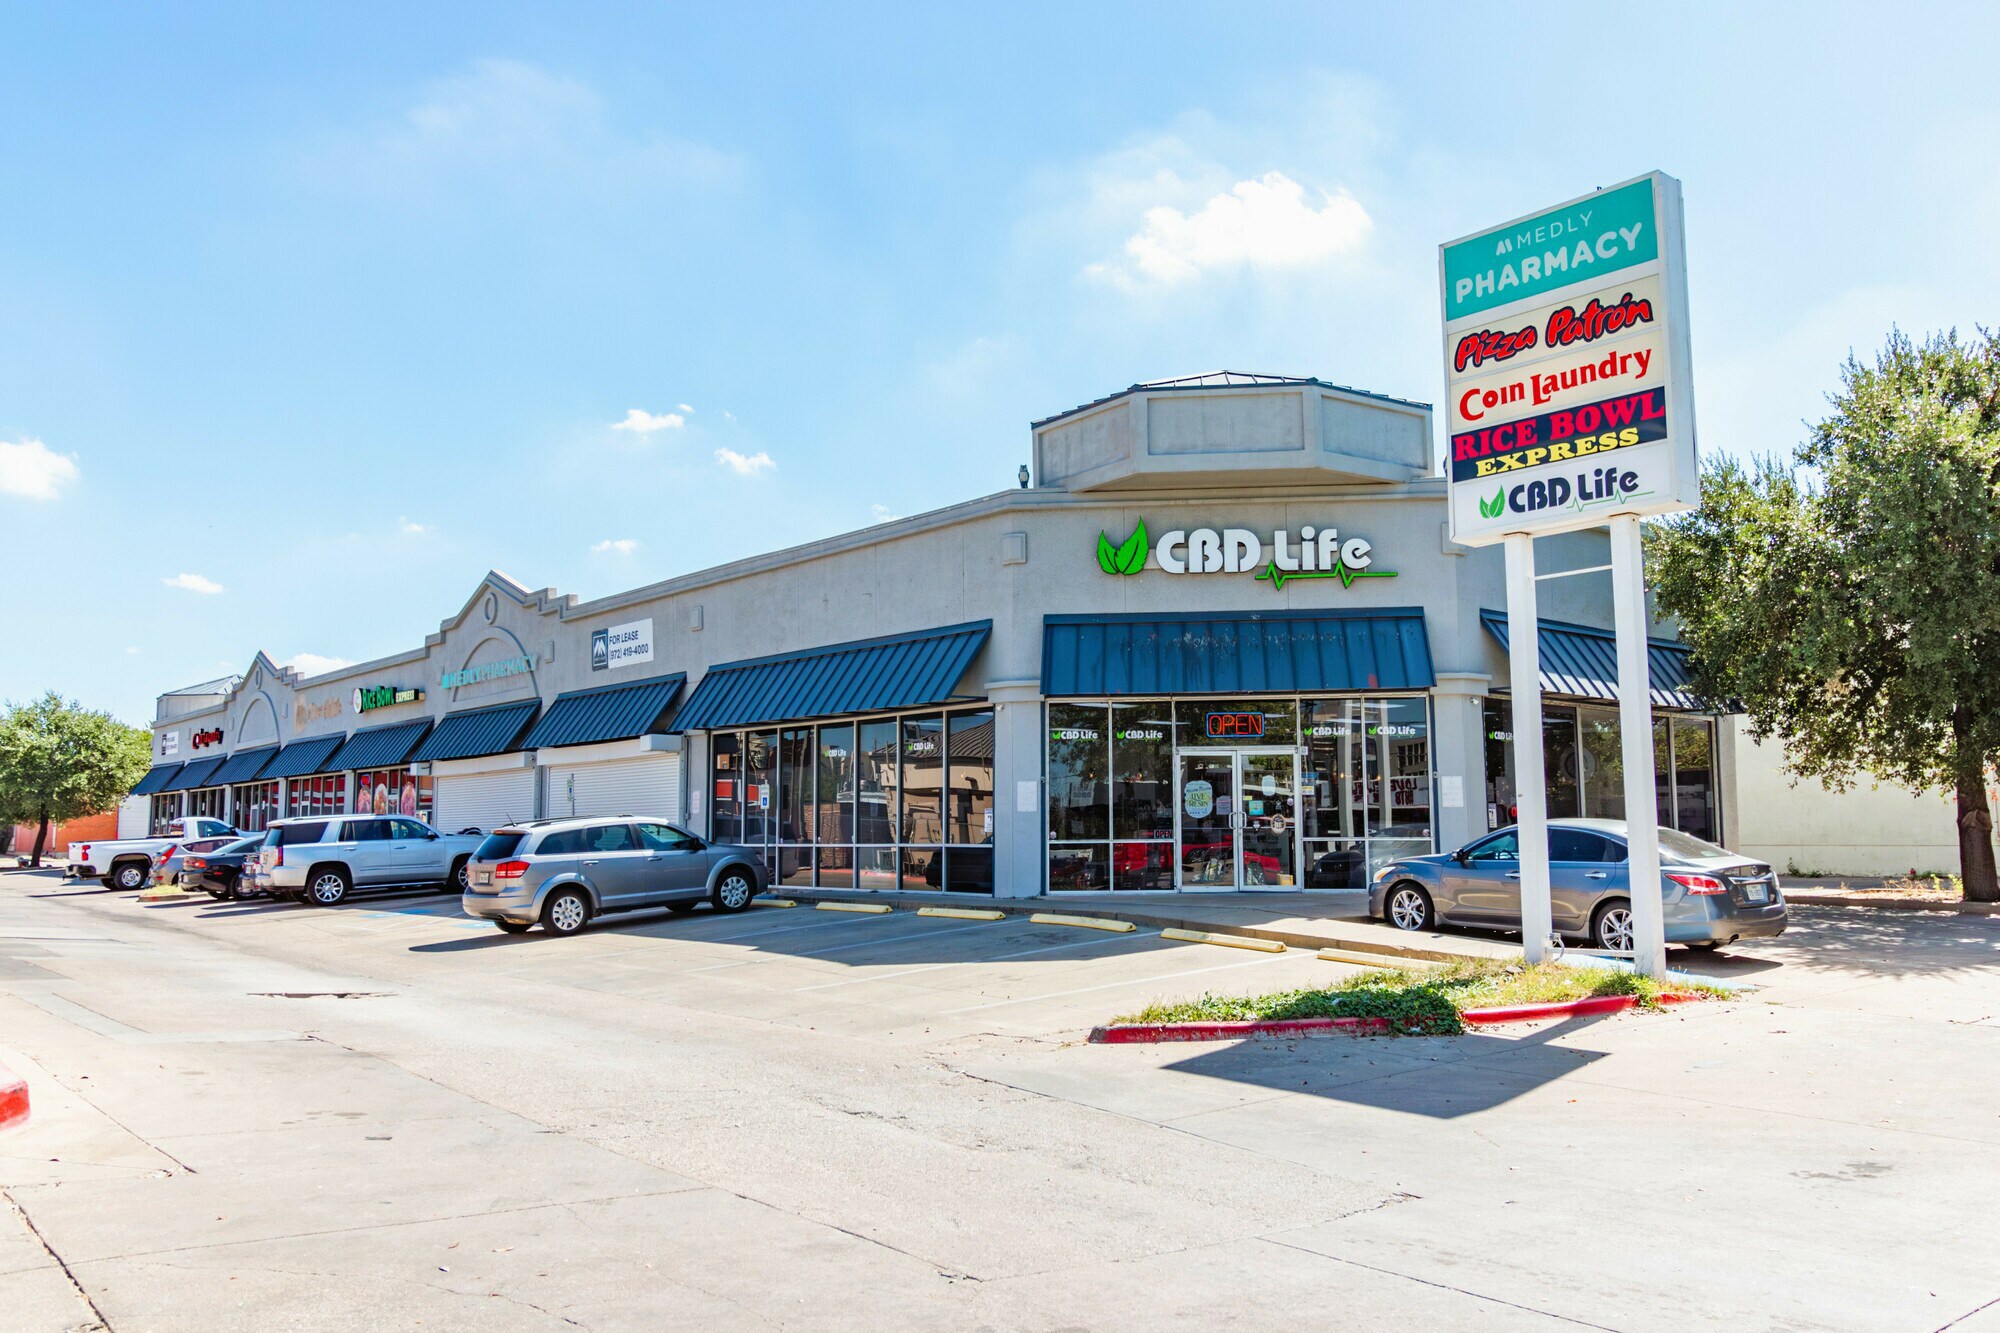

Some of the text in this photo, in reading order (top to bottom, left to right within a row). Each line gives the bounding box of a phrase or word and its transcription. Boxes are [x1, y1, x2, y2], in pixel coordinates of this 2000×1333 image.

[1517, 210, 1593, 249] MEDLY
[1456, 222, 1642, 304] PHARMACY
[1454, 292, 1654, 372] Pizza Patrón
[1459, 348, 1652, 421] Coin Laundry
[1454, 392, 1664, 462] RICE BOWL
[1476, 427, 1639, 477] EXPRESS
[1508, 466, 1639, 513] CBD Life
[1155, 525, 1372, 574] CBD Life
[609, 630, 639, 645] FOR LEASE
[609, 643, 649, 661] (972) 419-4000
[449, 655, 534, 687] MEDLY PHARMACY
[1060, 730, 1098, 740] CBD Life
[1125, 729, 1163, 739] CBD Life
[1209, 714, 1263, 735] OPEN
[1312, 726, 1351, 736] CBD Life
[1377, 726, 1416, 735] CBD Life
[1155, 830, 1173, 839] OPEN
